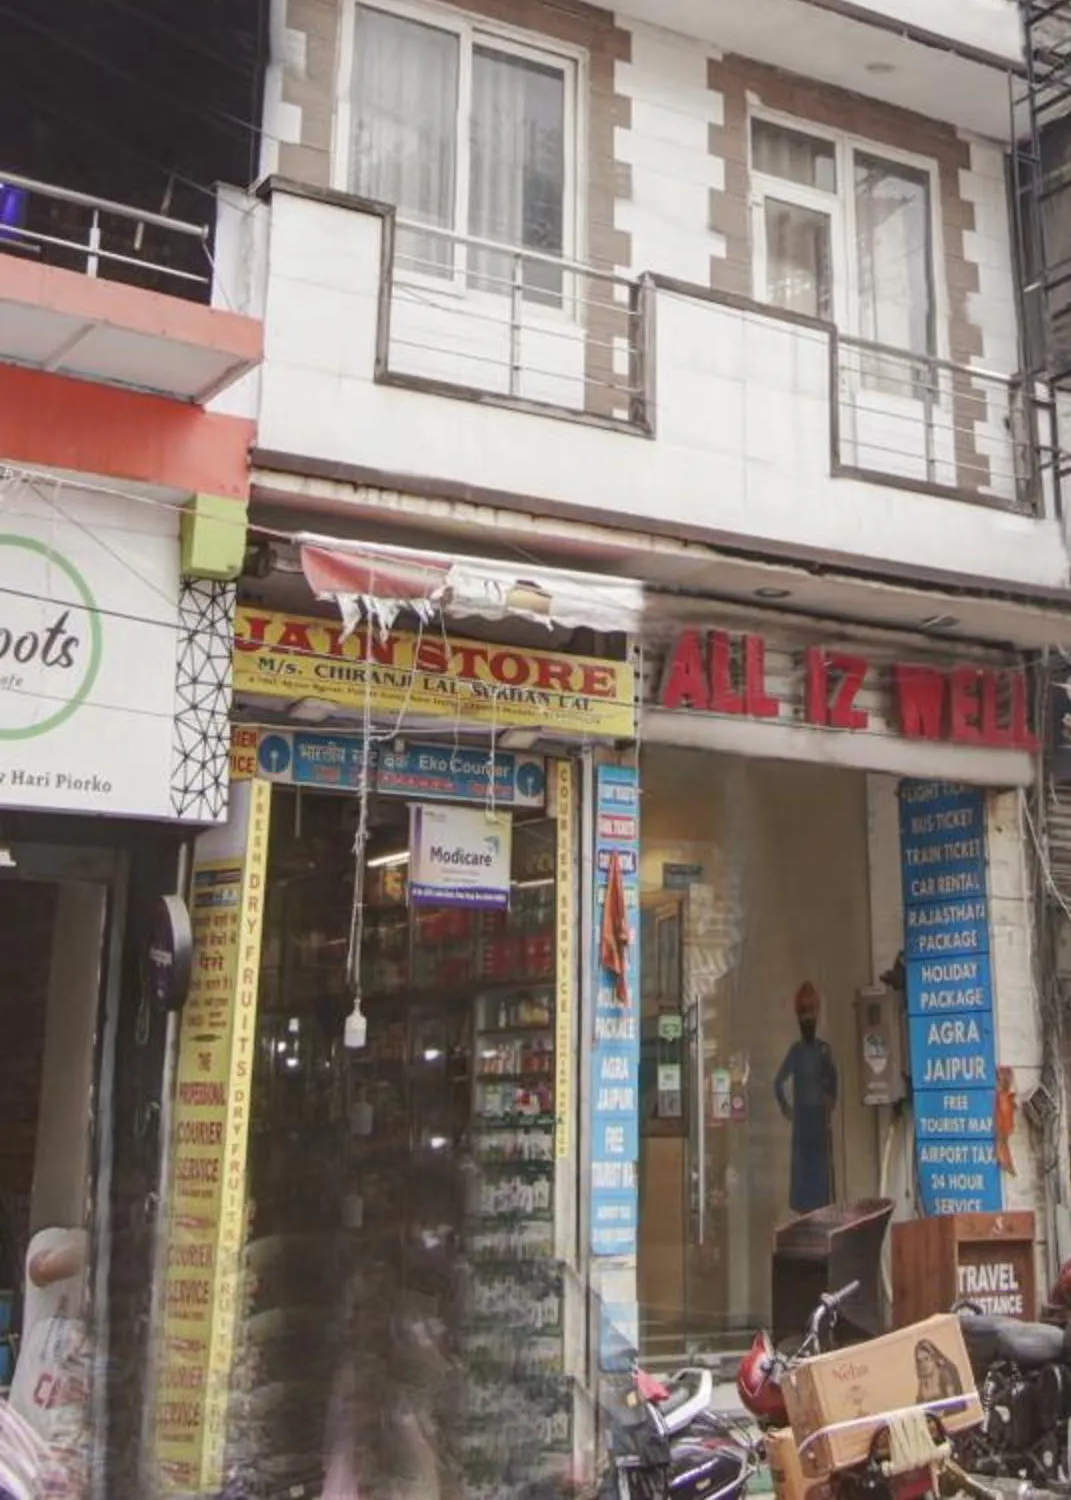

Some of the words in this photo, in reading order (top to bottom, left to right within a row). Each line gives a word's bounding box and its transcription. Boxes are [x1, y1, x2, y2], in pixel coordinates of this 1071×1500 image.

[234, 617, 400, 664] JAIN
[413, 639, 616, 698] STORE
[665, 625, 780, 717] ALL
[806, 644, 868, 729] IZ
[893, 661, 1040, 753] WELL
[419, 755, 447, 772] Eko
[10, 768, 50, 787] Hari
[935, 808, 973, 829] TICKET
[430, 845, 493, 867] Modicare
[938, 872, 981, 894] RENTAL
[247, 875, 260, 935] DRY
[919, 929, 977, 952] PACKAGE
[921, 963, 977, 984] HOLIDAY
[920, 987, 984, 1011] PACKAGE
[237, 944, 254, 1077] FRUITS
[928, 1020, 980, 1045] AGRA
[924, 1057, 986, 1082] JAIPUR
[943, 1095, 969, 1111] FREE
[176, 1120, 223, 1146] COURIER
[921, 1117, 965, 1133] TOURIST
[921, 1147, 971, 1165] AIRPORT
[949, 1174, 985, 1191] HOUR
[934, 1199, 983, 1214] SERVICE
[957, 1263, 1018, 1293] TRAVEL
